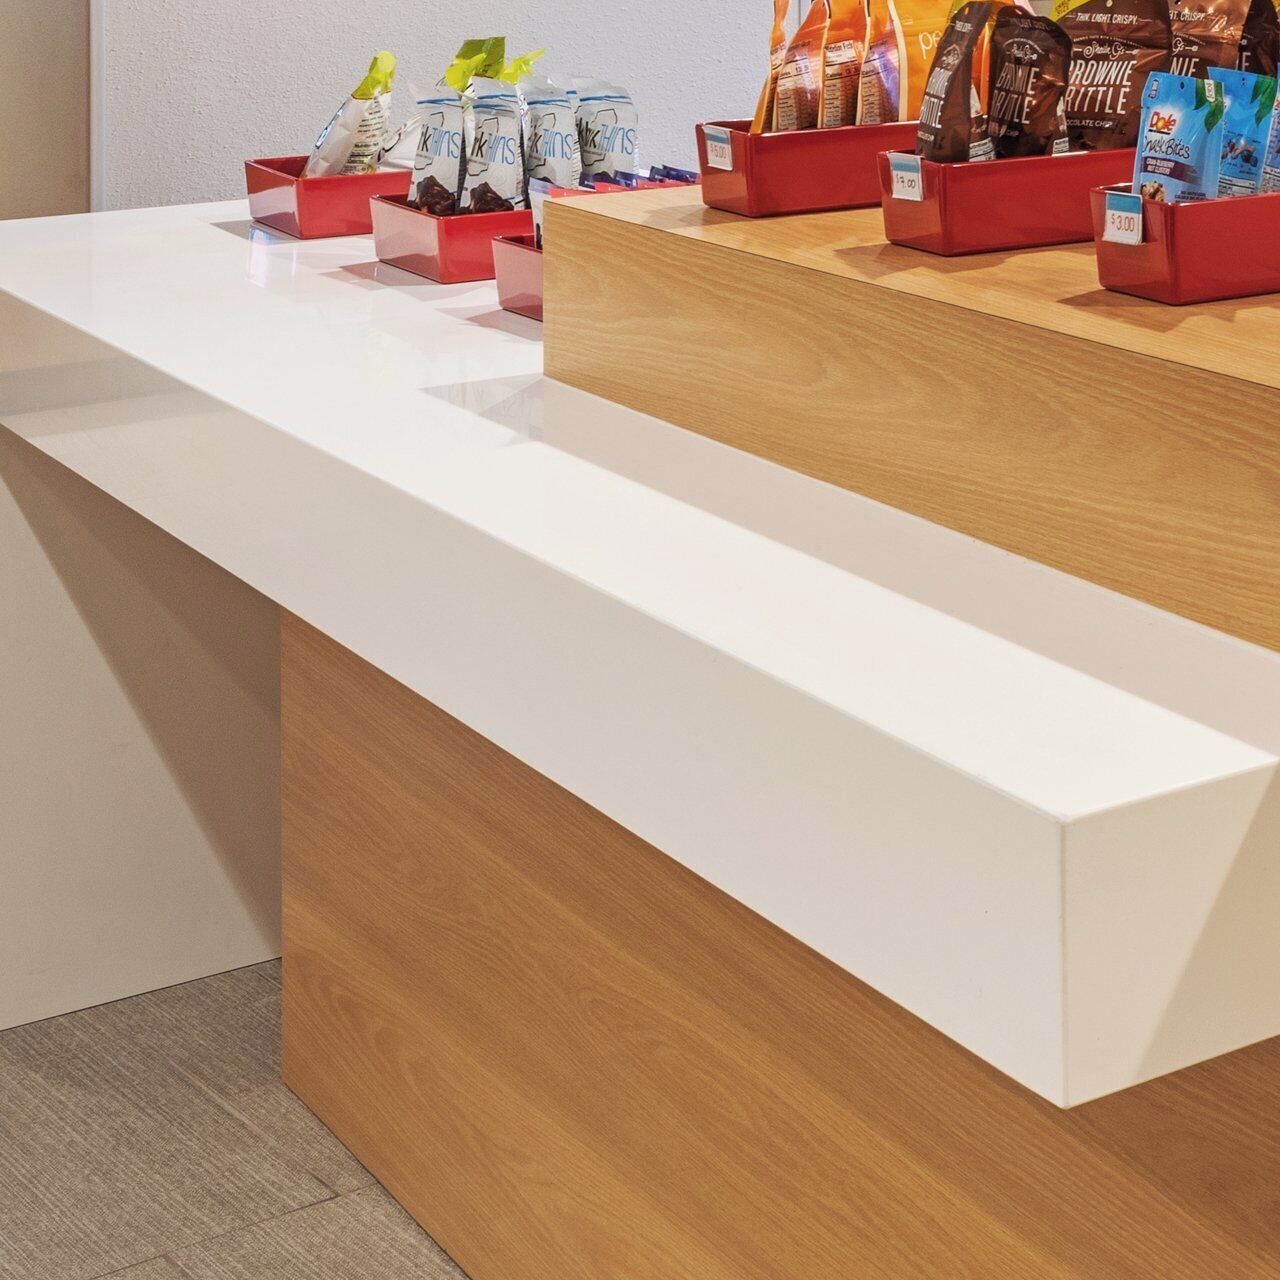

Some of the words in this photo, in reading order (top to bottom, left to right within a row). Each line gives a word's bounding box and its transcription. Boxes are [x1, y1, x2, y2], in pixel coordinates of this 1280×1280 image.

[995, 62, 1040, 96] BROWNIE
[1065, 86, 1131, 114] RITTLE
[1150, 111, 1176, 132] Dole
